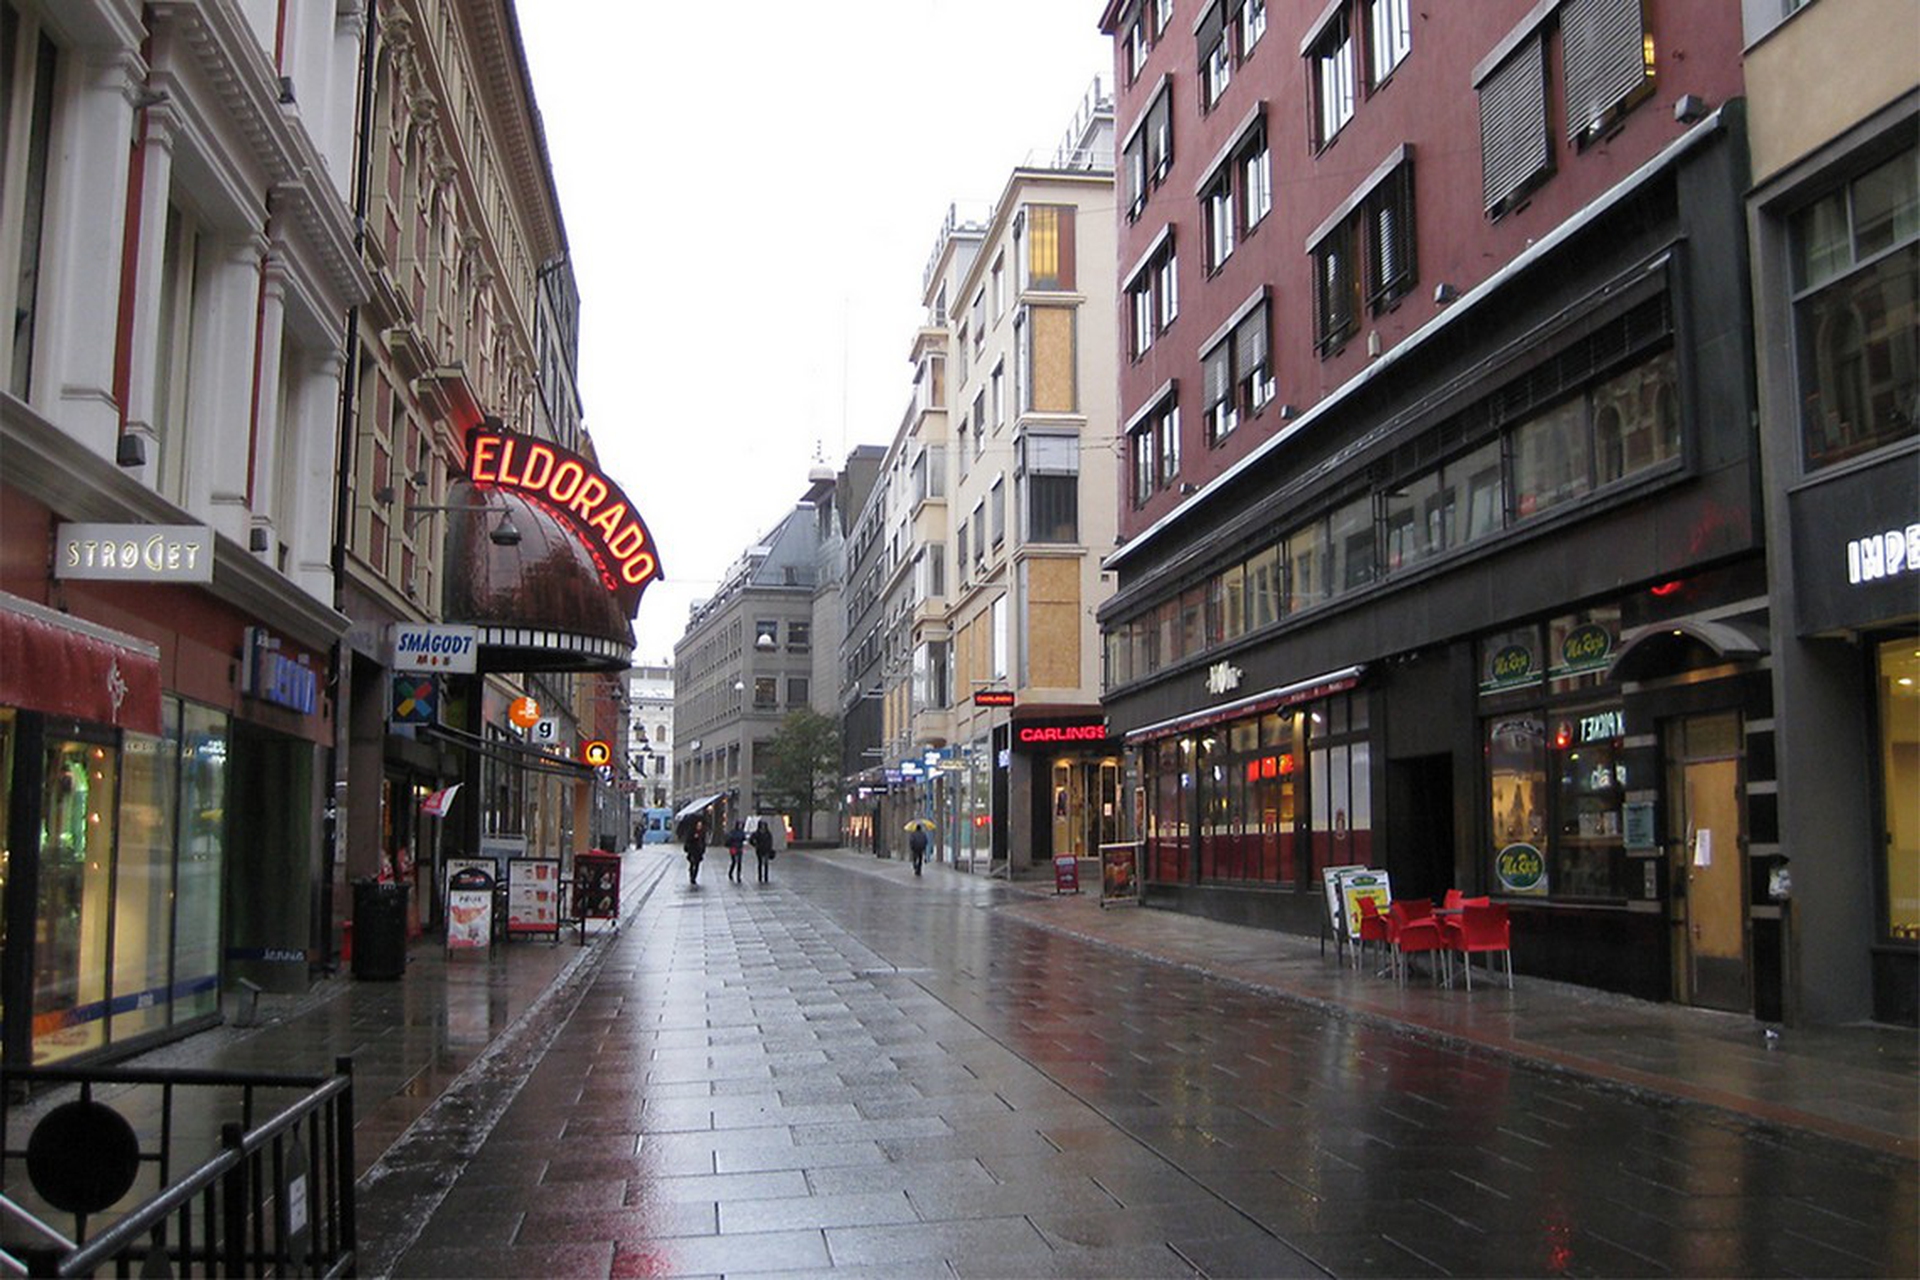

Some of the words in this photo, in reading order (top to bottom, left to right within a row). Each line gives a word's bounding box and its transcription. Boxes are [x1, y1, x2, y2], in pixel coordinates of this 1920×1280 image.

[471, 436, 655, 585] ELDORADO
[398, 629, 473, 654] SMÅGODT
[1020, 724, 1105, 742] CARLINGS
